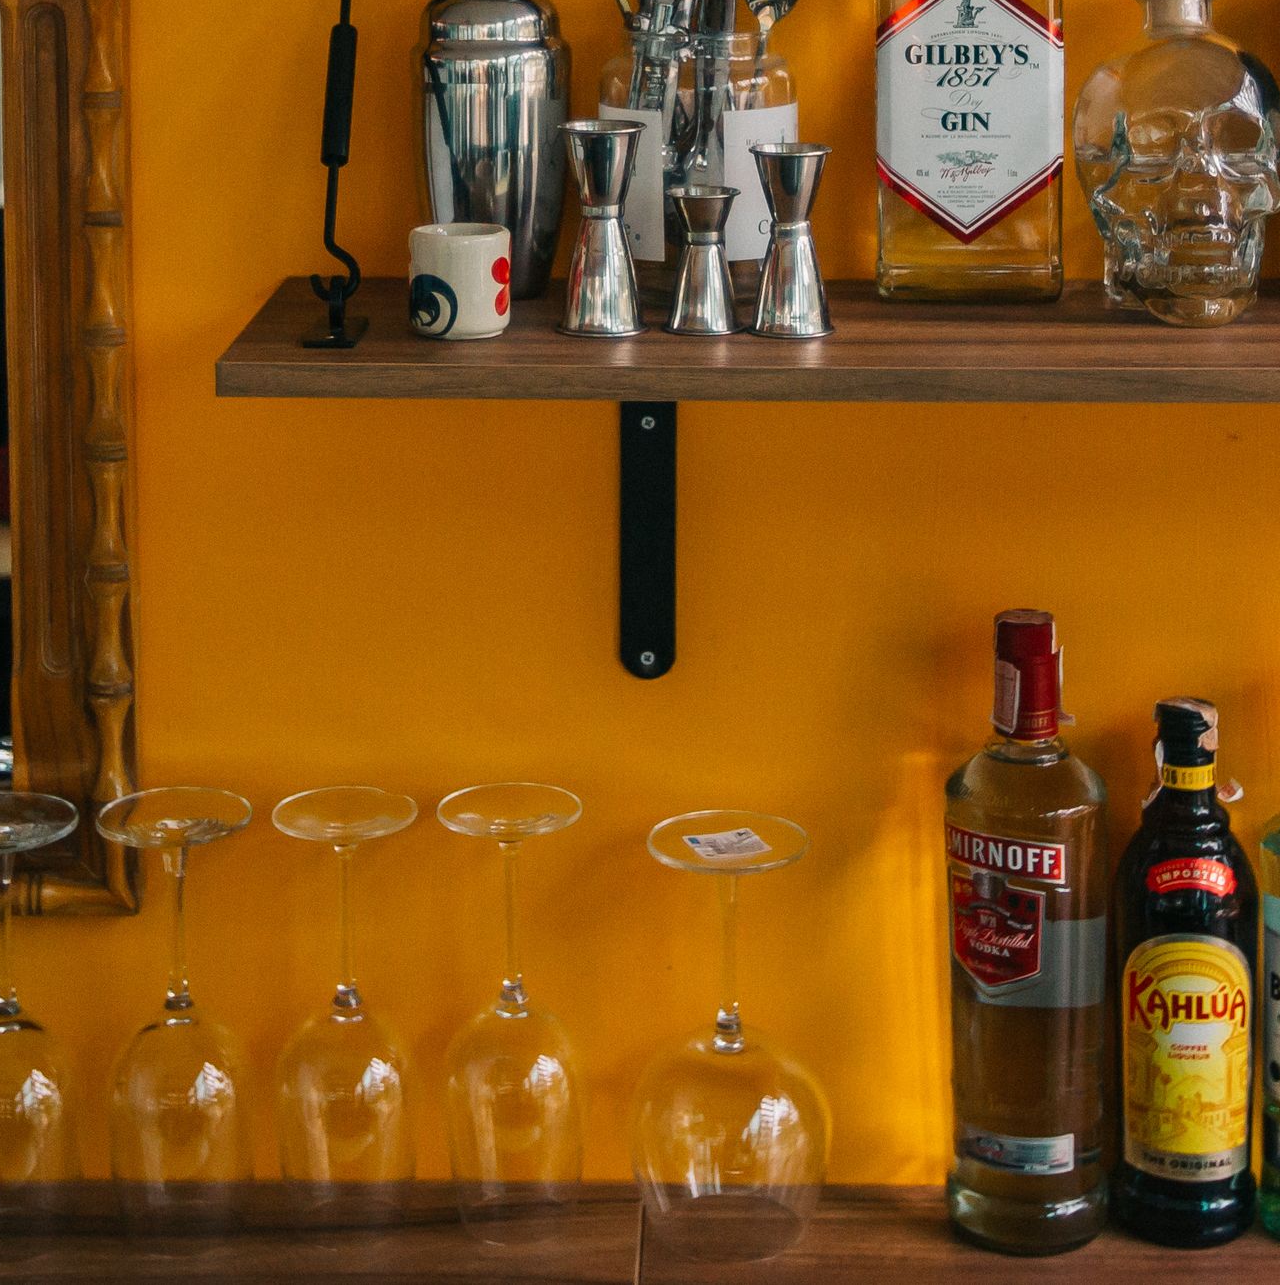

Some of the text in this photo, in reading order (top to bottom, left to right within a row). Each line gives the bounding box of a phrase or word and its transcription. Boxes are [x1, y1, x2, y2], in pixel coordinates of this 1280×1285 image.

[904, 44, 1029, 65] GILBEY'S
[936, 66, 1001, 87] 1857
[949, 90, 983, 109] Dry
[941, 111, 991, 131] GIN
[948, 827, 1057, 875] MIRNOFF
[1155, 868, 1227, 886] IMPORTED
[970, 939, 1010, 957] VODKA
[1129, 971, 1247, 1031] KAHLÚA
[1168, 1157, 1233, 1170] ORIGINAL
